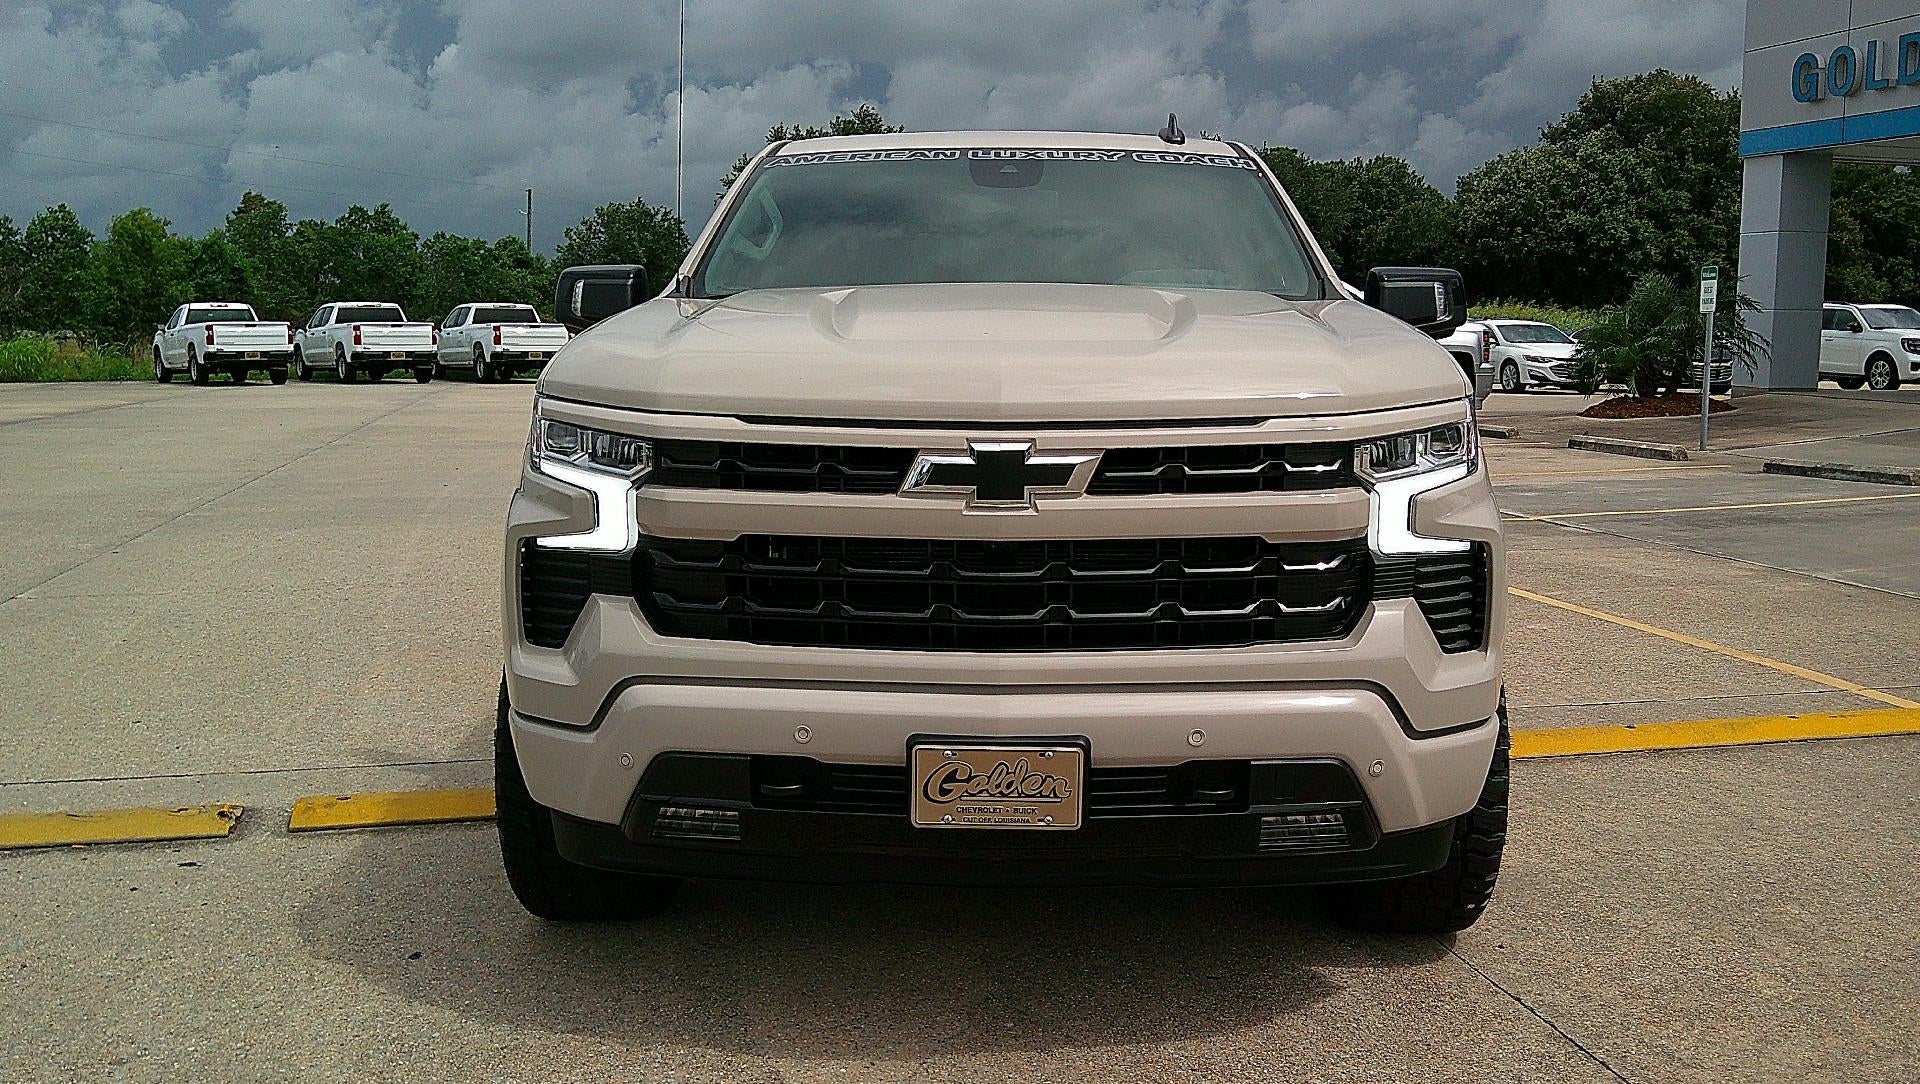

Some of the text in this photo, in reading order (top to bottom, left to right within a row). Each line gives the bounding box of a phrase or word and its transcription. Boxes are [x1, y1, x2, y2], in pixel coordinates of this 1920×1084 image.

[763, 149, 1258, 170] AMERICAN LUXURY COACH
[922, 757, 1073, 804] Golden
[955, 806, 1038, 816] CHEVROLET BUICK
[962, 816, 977, 824] CUT
[993, 816, 1031, 824] LOUISIANA
